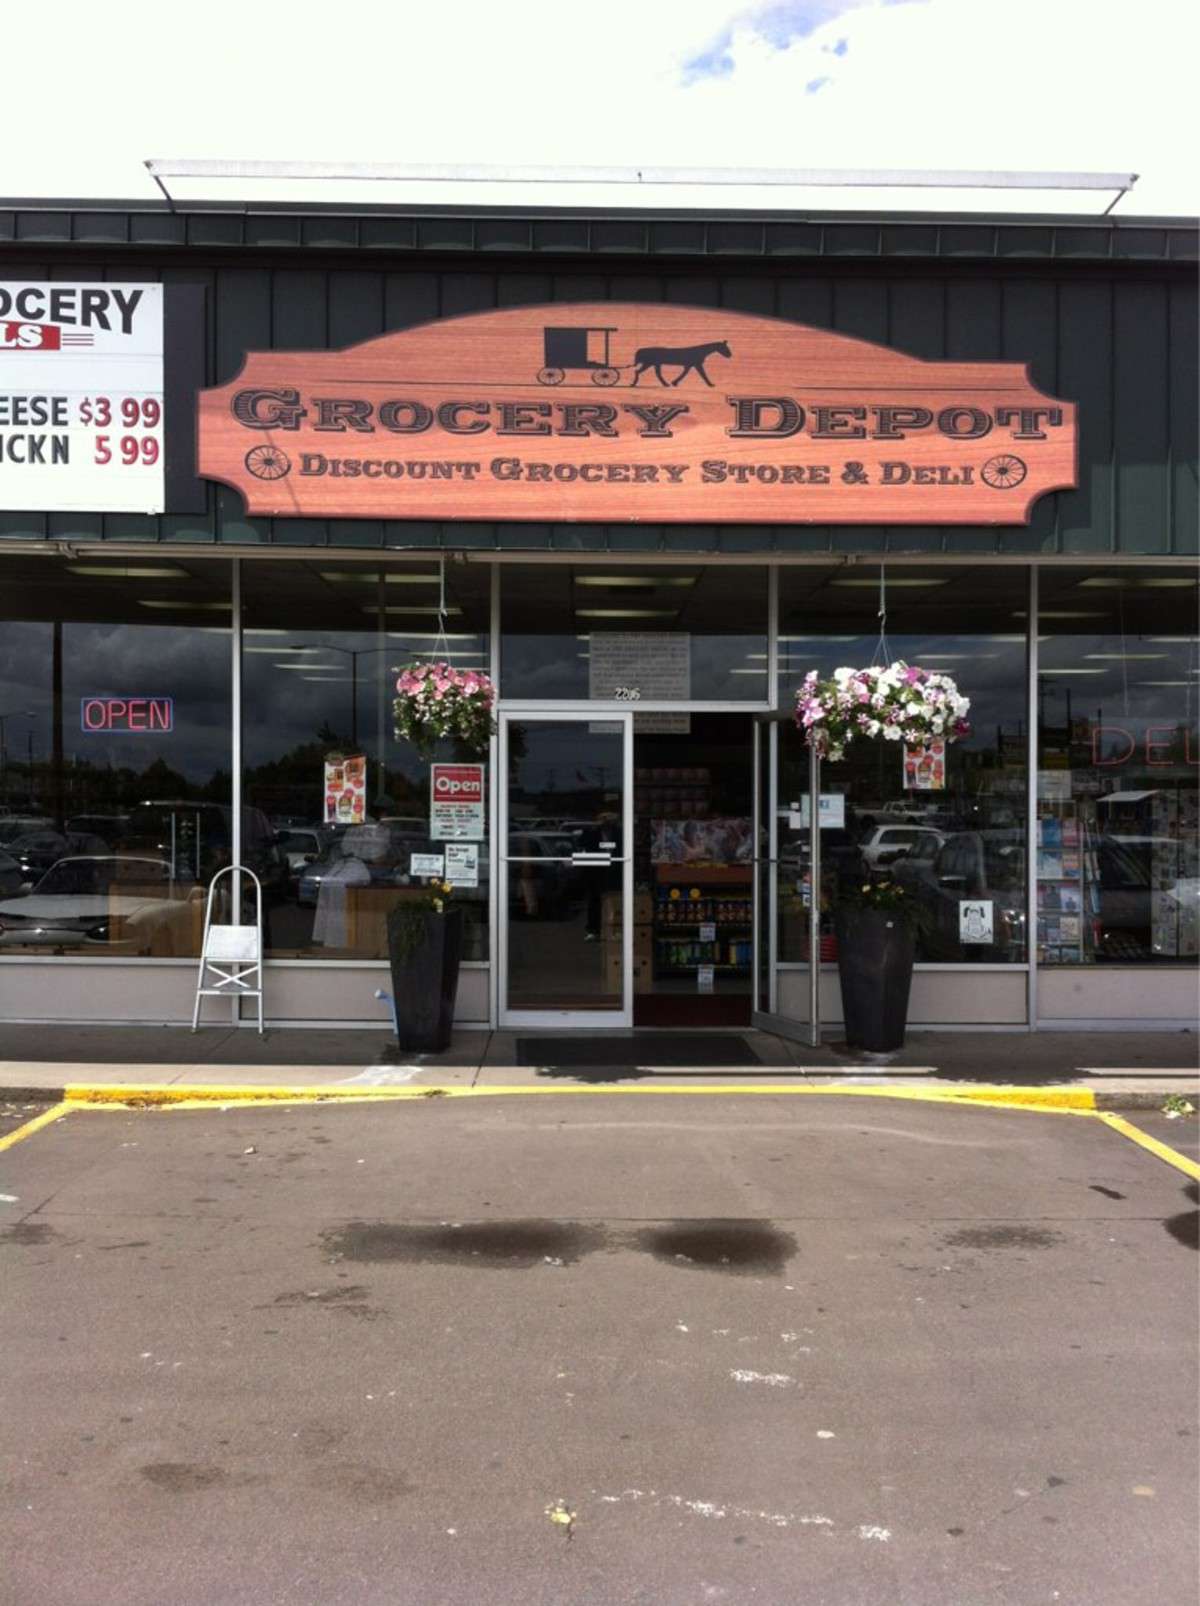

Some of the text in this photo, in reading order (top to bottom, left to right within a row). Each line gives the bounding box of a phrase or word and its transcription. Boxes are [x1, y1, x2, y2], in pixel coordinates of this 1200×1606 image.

[231, 388, 1063, 440] GROCERY DEPOT
[299, 453, 975, 485] DISCOUNT GROCERY STORE & DELI
[85, 700, 170, 730] OPEN
[436, 776, 480, 794] Open
